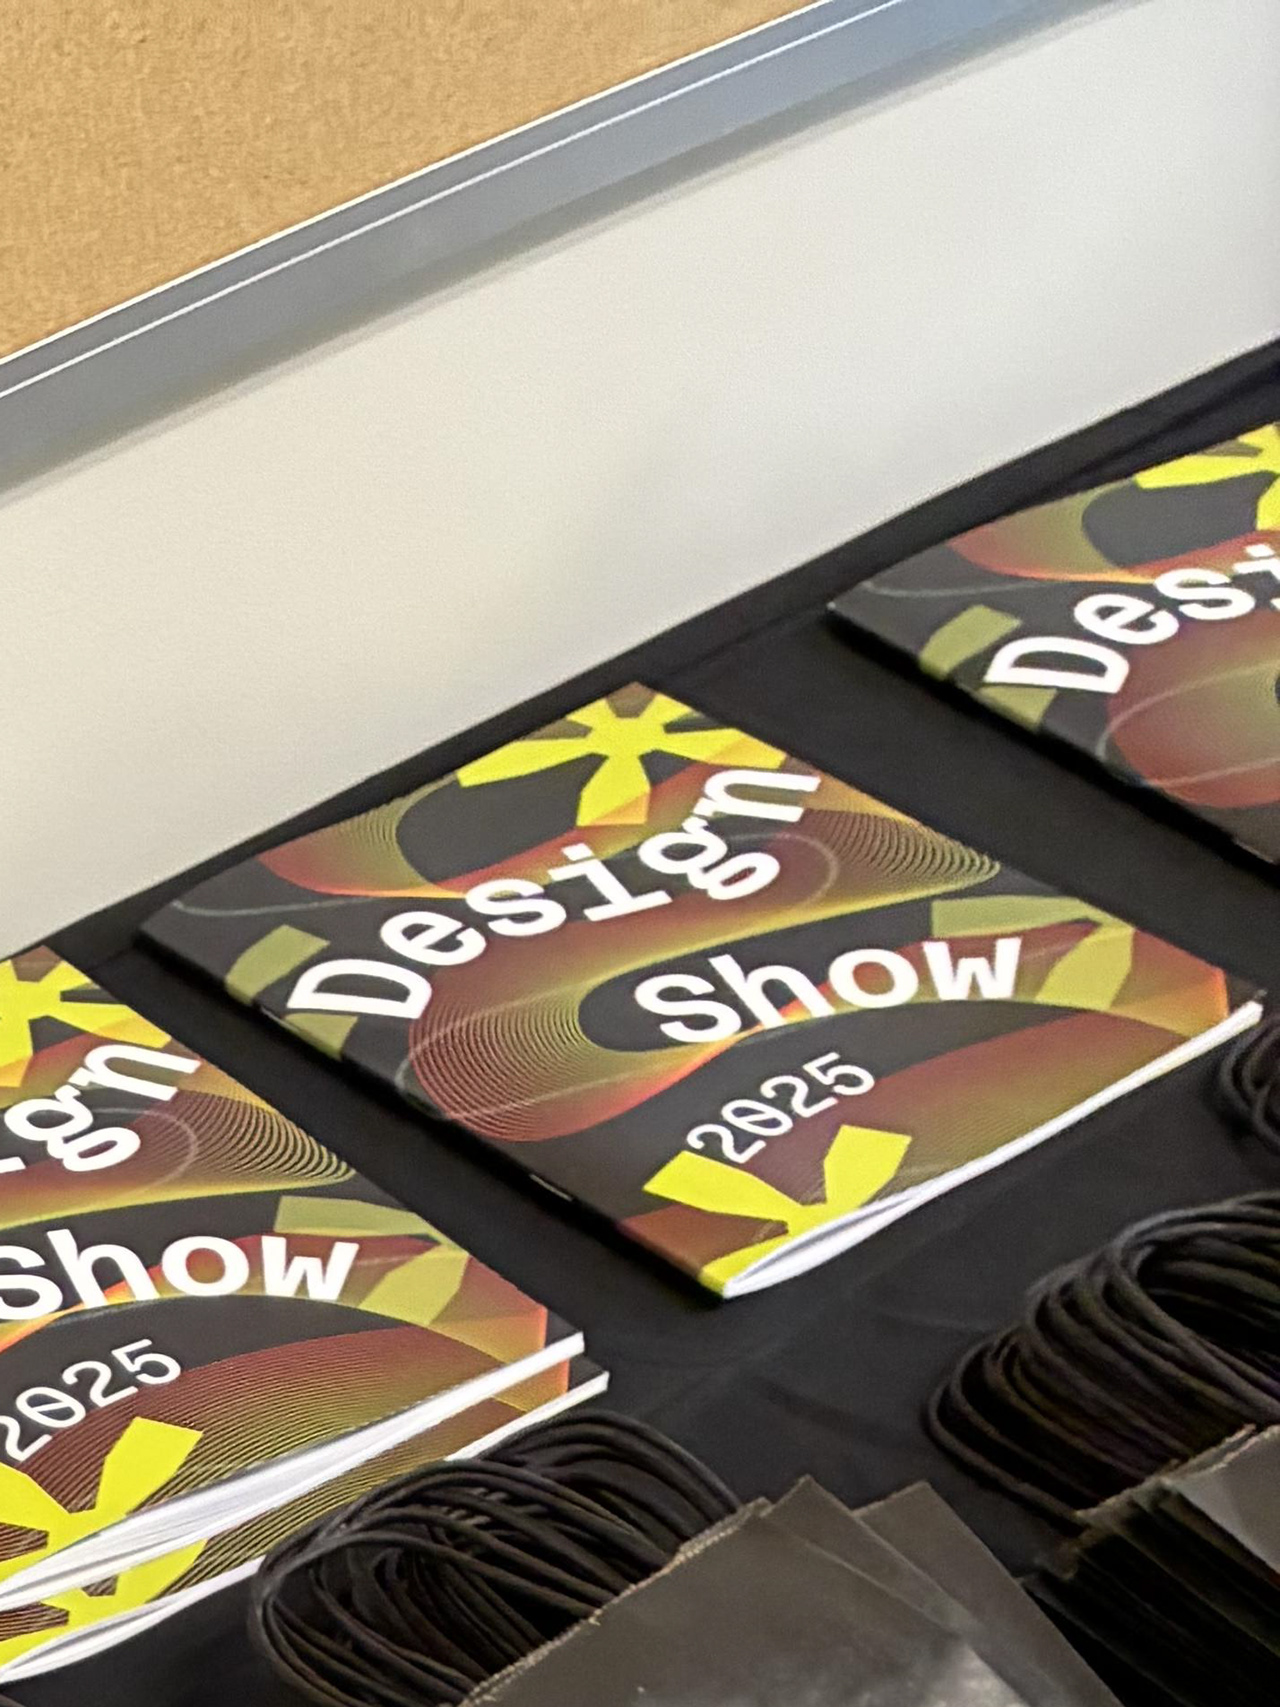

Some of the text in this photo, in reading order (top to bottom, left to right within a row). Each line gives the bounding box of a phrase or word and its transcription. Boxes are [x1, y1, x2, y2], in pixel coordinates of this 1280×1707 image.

[285, 765, 822, 1020] Design
[632, 936, 1023, 1045] Show
[686, 1050, 876, 1165] 2025
